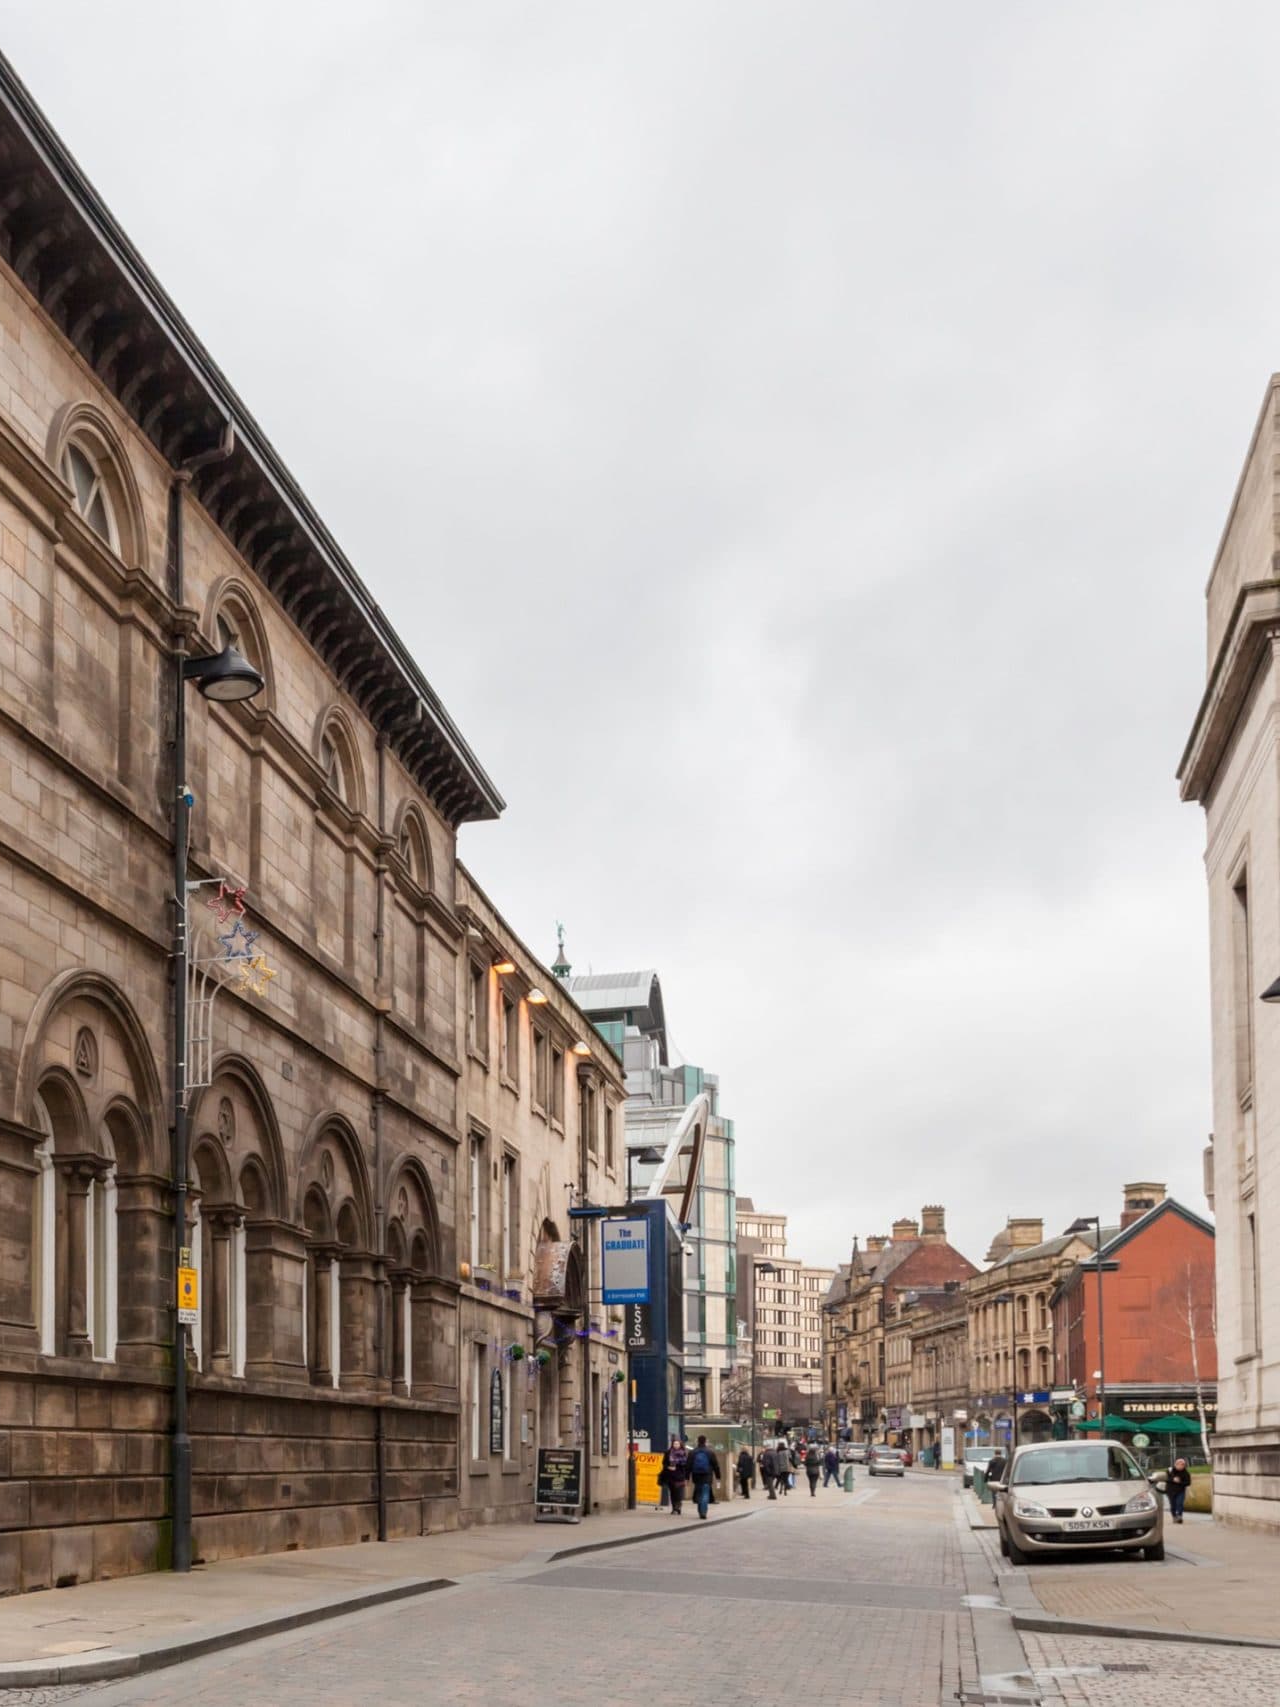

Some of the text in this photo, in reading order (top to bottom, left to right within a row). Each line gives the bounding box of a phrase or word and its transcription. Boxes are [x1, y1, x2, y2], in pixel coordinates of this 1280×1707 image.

[618, 1228, 632, 1238] The
[605, 1240, 645, 1250] GRADUATE
[628, 1337, 646, 1346] CLUB
[1123, 1403, 1194, 1412] STARBUCKS
